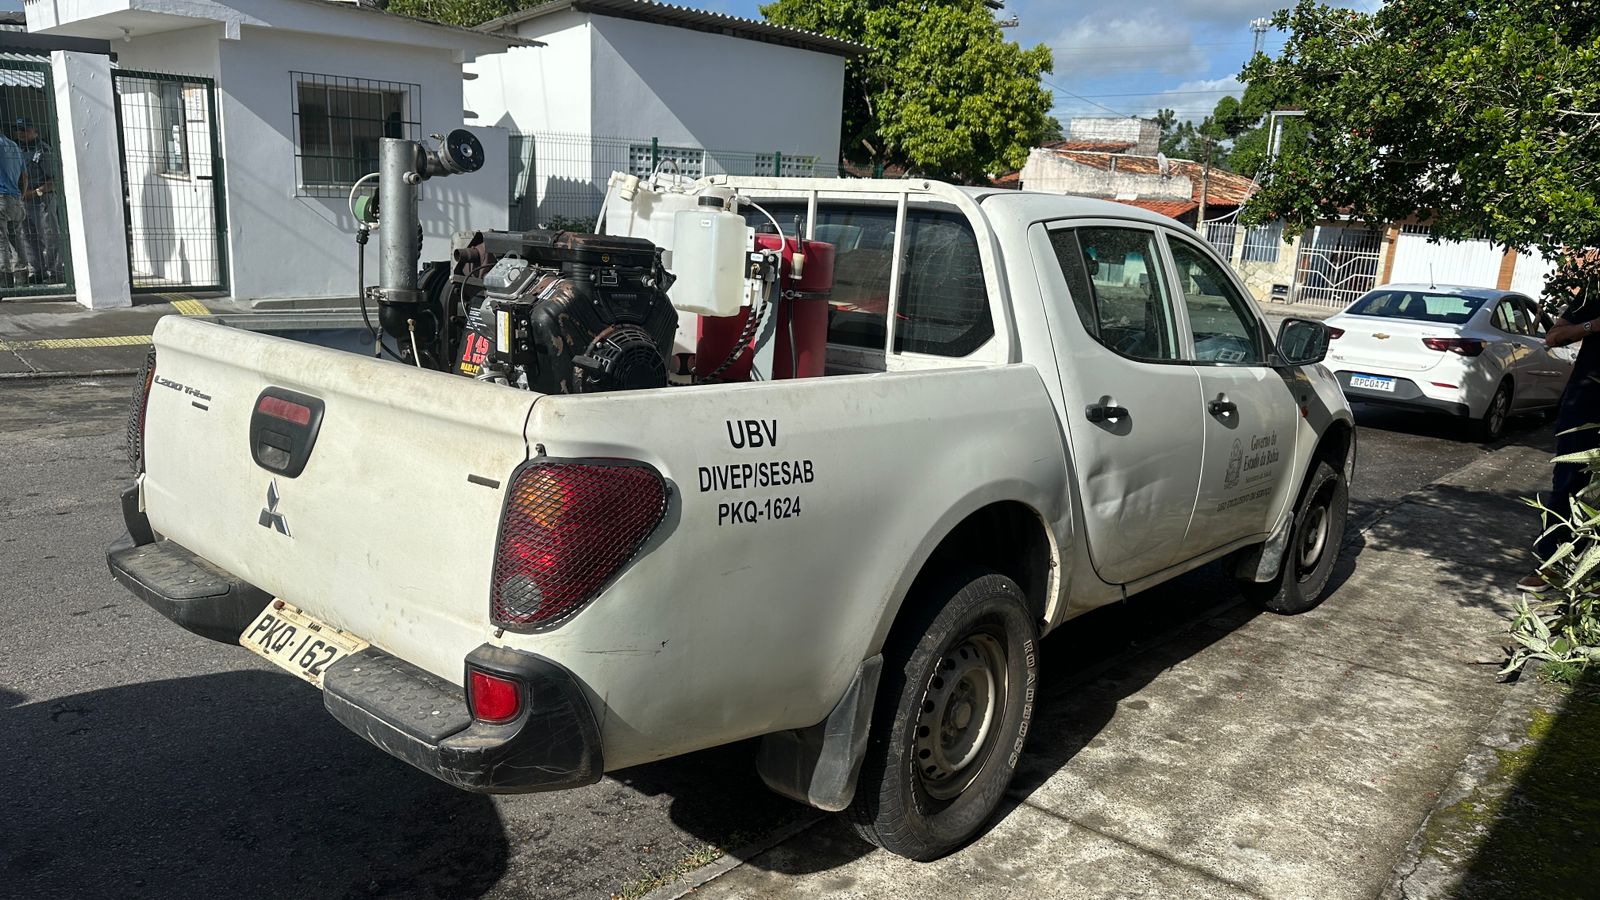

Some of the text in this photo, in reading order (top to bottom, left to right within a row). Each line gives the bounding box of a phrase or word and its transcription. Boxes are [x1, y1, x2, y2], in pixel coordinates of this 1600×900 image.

[154, 375, 183, 392] L200
[726, 419, 777, 449] UBV
[1251, 435, 1270, 451] Governo
[1243, 452, 1260, 471] Estado
[1266, 448, 1279, 465] Bahia
[698, 459, 814, 492] DIVEP/SESAB
[718, 496, 801, 526] PKQ-1624
